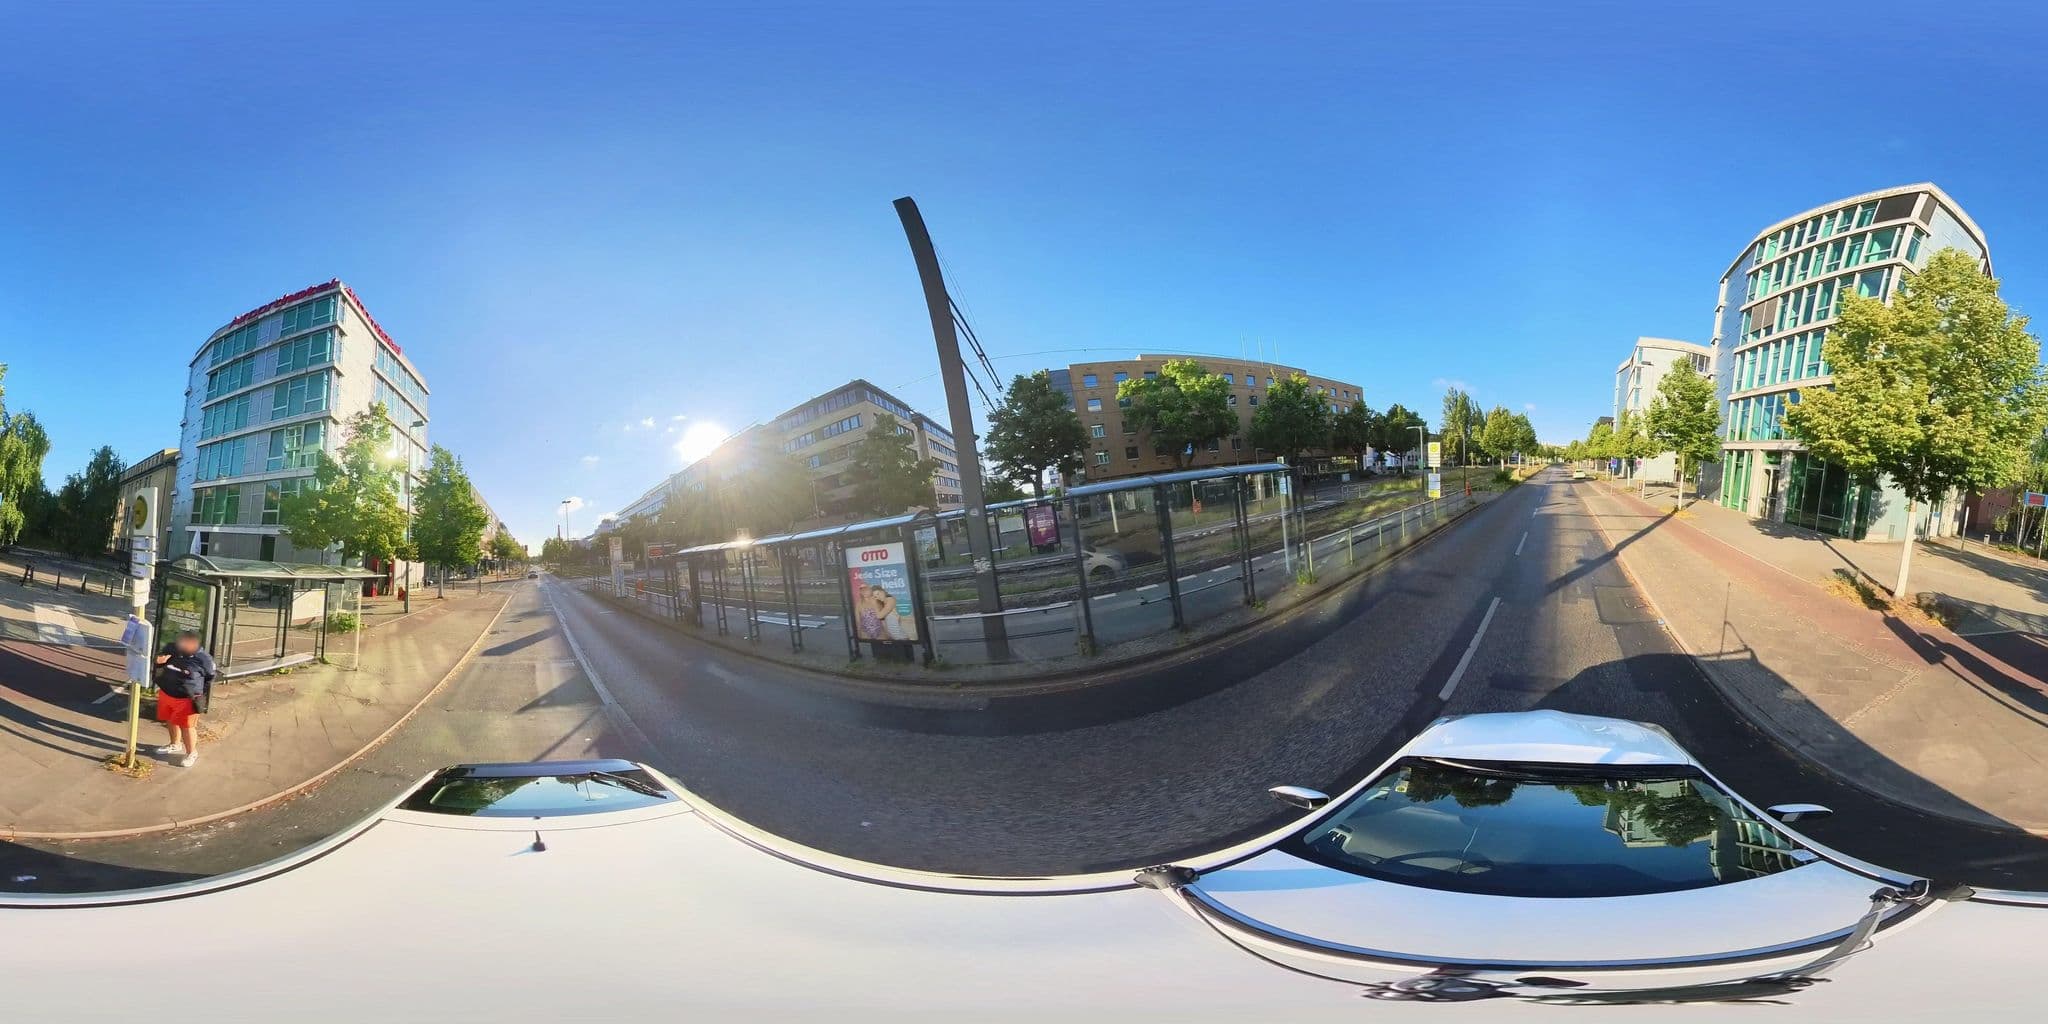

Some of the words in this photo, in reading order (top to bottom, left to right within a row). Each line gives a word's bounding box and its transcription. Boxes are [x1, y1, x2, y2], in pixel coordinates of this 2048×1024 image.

[861, 549, 888, 562] OTTO
[853, 570, 873, 580] Jede
[874, 567, 898, 579] Size
[881, 578, 905, 589] heiß
